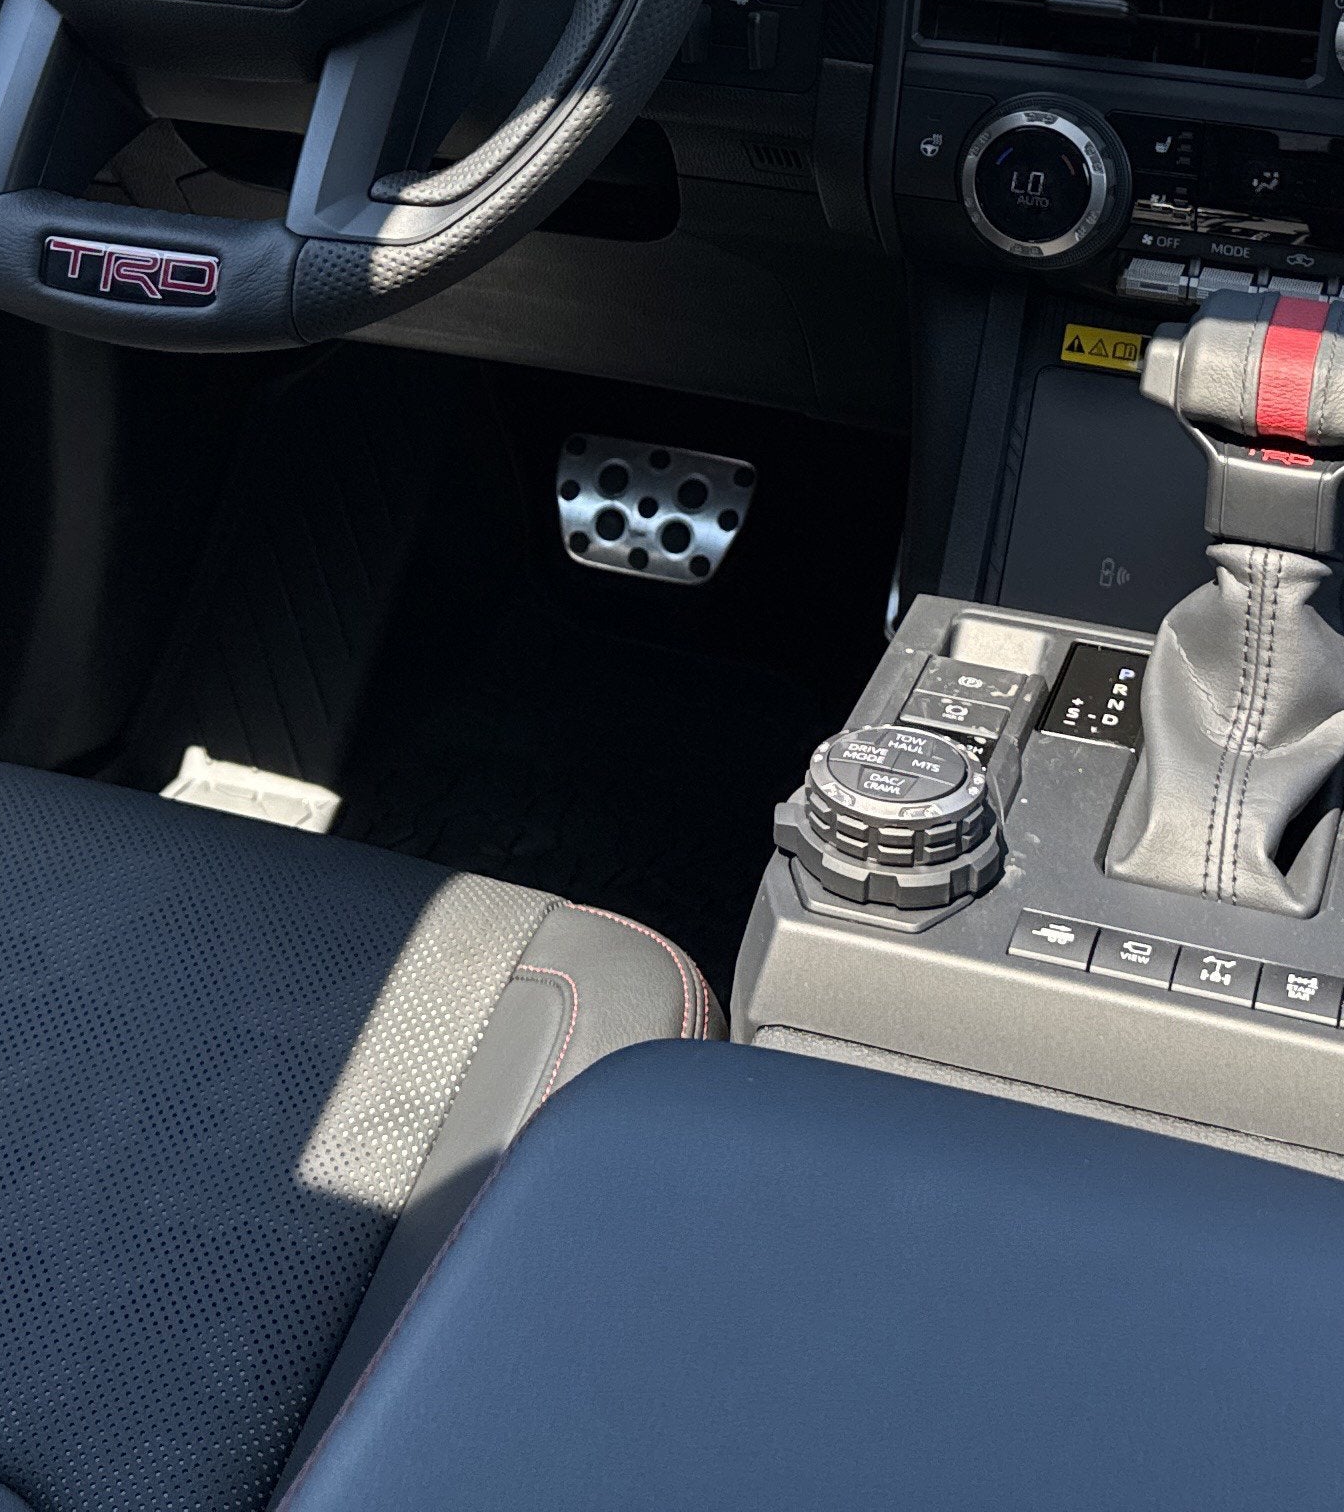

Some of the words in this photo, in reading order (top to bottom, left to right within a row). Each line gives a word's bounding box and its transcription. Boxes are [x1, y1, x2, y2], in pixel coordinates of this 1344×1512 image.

[1010, 171, 1045, 196] LO
[1017, 196, 1050, 208] AUTO
[1156, 237, 1180, 249] OFF
[1210, 243, 1251, 259] MODE
[49, 238, 219, 299] TRD
[1119, 668, 1135, 680] P
[1112, 683, 1128, 696] R
[1107, 698, 1124, 711] N
[1066, 707, 1080, 719] S
[1101, 714, 1119, 726] D
[895, 733, 927, 745] TOW
[847, 743, 889, 756] DRIVE
[888, 741, 924, 754] HAUL
[842, 751, 886, 764] MODE
[911, 759, 941, 773] MTS
[869, 773, 906, 786] DAC/
[863, 781, 901, 795] CRAWL
[1120, 952, 1151, 965] VIEW
